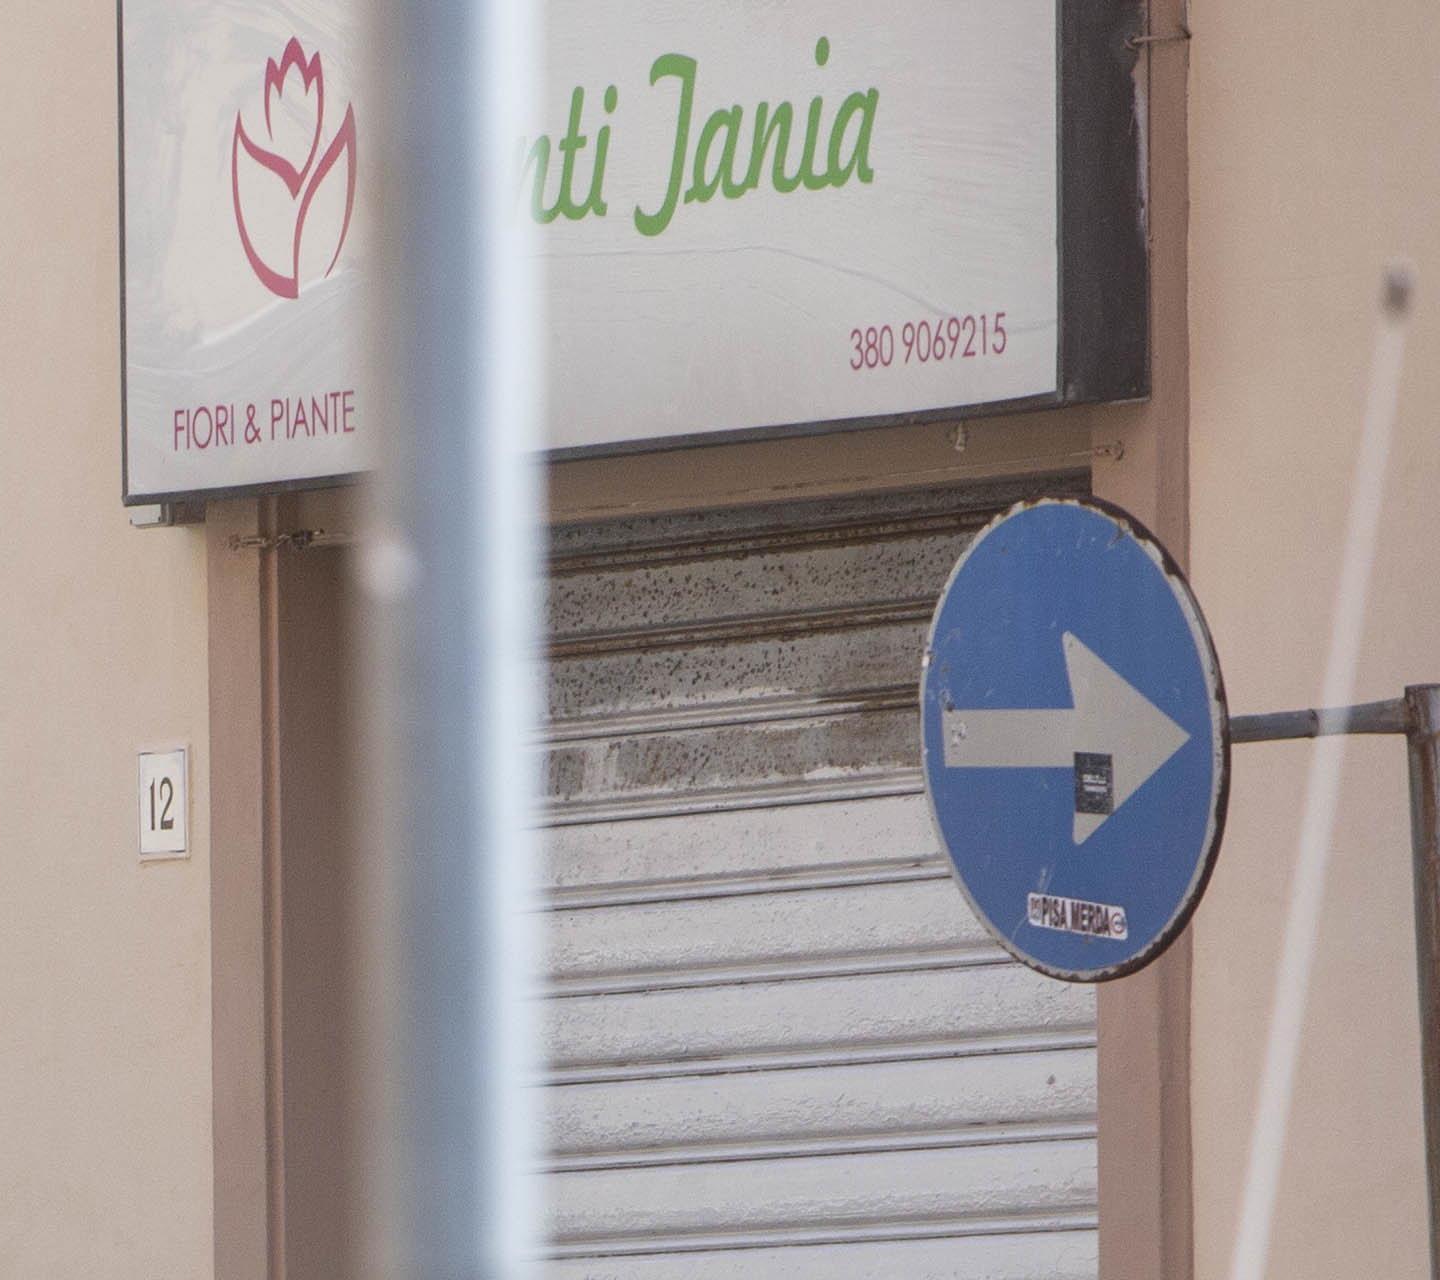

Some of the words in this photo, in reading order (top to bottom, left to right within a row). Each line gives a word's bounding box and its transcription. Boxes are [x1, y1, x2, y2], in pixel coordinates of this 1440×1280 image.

[518, 84, 618, 224] nti
[850, 324, 894, 371] 380
[902, 312, 1007, 364] 9069215
[174, 403, 234, 451] FIORI
[244, 403, 262, 444] &
[271, 390, 355, 441] PIANTE
[150, 776, 175, 831] 12
[1042, 897, 1067, 928] PISA
[1071, 901, 1111, 936] MERDA
